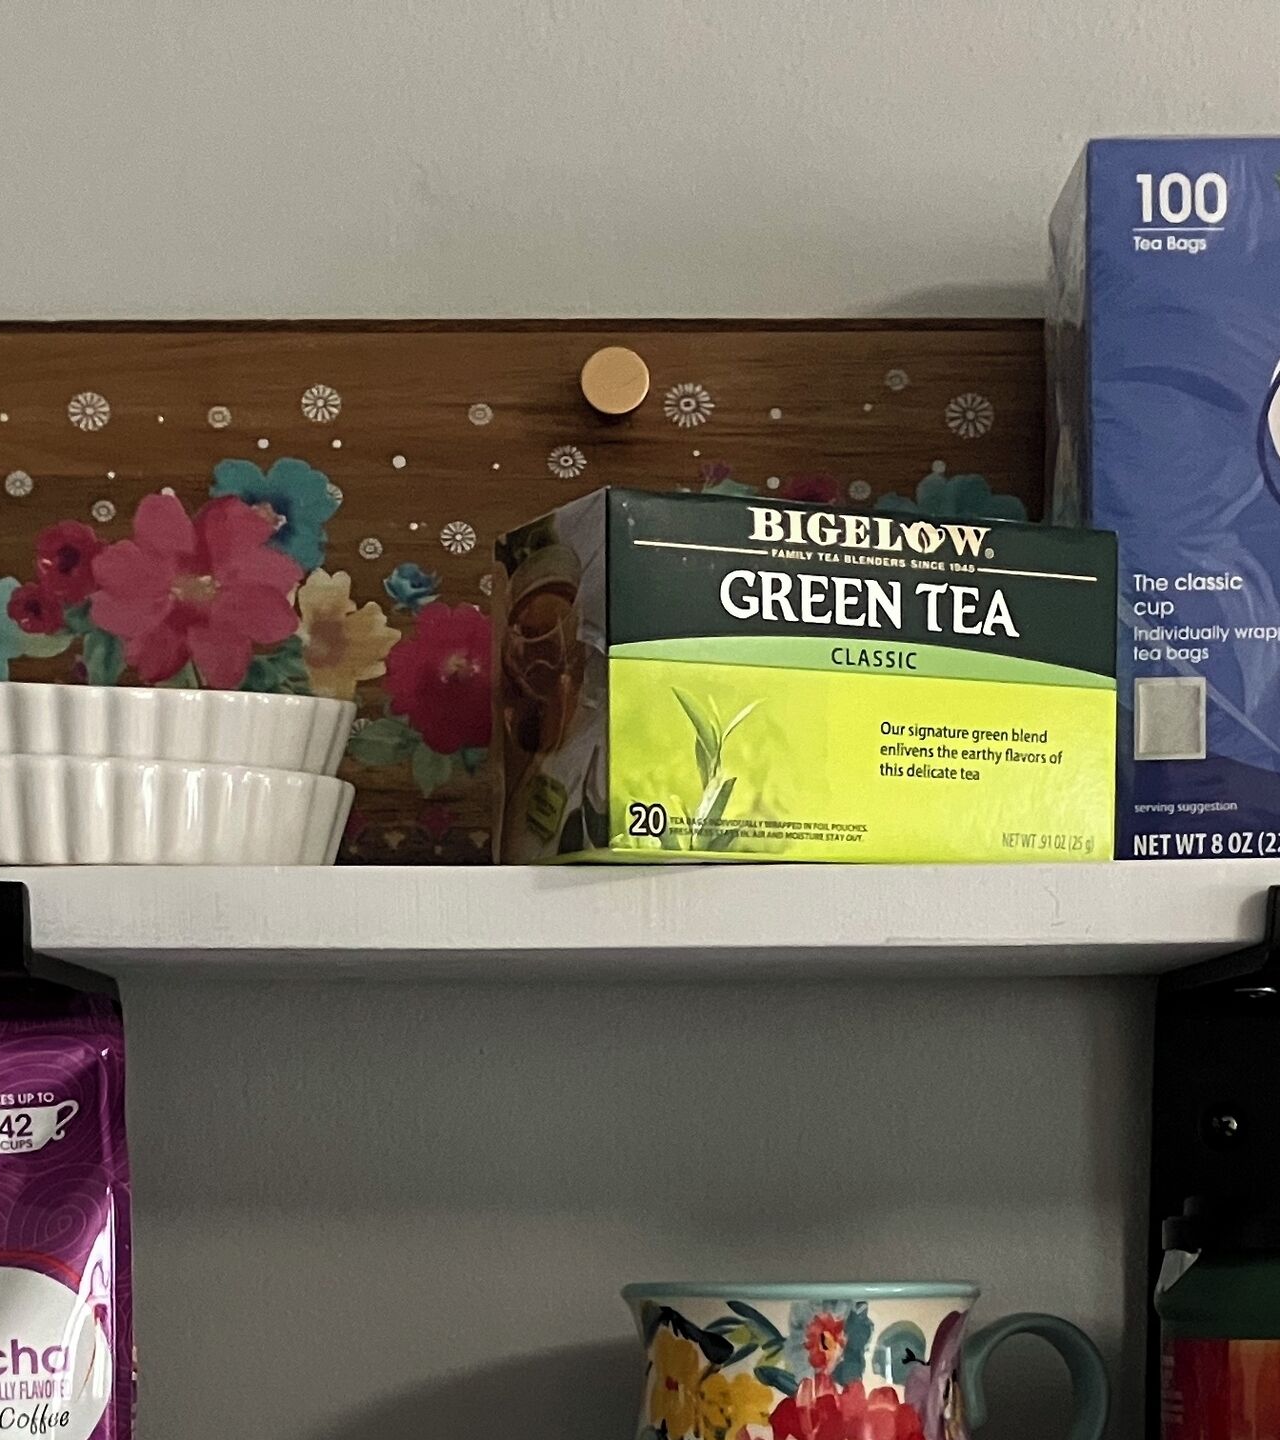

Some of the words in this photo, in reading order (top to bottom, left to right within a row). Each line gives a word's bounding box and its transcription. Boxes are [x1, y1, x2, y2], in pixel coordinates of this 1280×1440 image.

[1136, 172, 1228, 224] 100
[1133, 236, 1162, 251] Tea
[1167, 236, 1207, 253] Bags
[747, 506, 991, 557] BIGELOW
[772, 549, 812, 560] FAMILY
[817, 552, 839, 563] TEA
[844, 554, 906, 568] BLENDERS
[910, 559, 944, 571] SINCE
[949, 562, 975, 573] 1945
[1134, 573, 1169, 592] The
[1174, 572, 1243, 591] classic
[720, 569, 901, 629] GREEN
[915, 582, 1020, 638] TEA
[1134, 601, 1175, 618] cup
[1133, 625, 1230, 642] Individually
[831, 647, 917, 669] CLASSIC
[1133, 646, 1162, 661] tea
[1166, 645, 1209, 663] bags
[880, 721, 905, 736] Our
[908, 724, 969, 741] signature
[972, 728, 1008, 743] green
[1012, 728, 1048, 743] blend
[880, 743, 934, 759] enlivens
[937, 745, 958, 760] the
[961, 747, 1002, 765] earthy
[1005, 748, 1046, 764] flavors
[1049, 751, 1063, 765] of
[880, 763, 903, 777] this
[907, 764, 957, 780] delicate
[961, 768, 980, 781] tea
[1134, 802, 1175, 814] serving
[1177, 801, 1238, 814] suggestion
[629, 803, 667, 836] 20
[1133, 834, 1172, 856] NET
[1175, 833, 1207, 855] WT
[1211, 833, 1222, 854] 8
[1227, 832, 1254, 854] OZ
[18, 1093, 34, 1105] UP
[36, 1092, 54, 1103] TO
[0, 1139, 33, 1151] CUPS
[0, 1404, 70, 1435] Coffee
